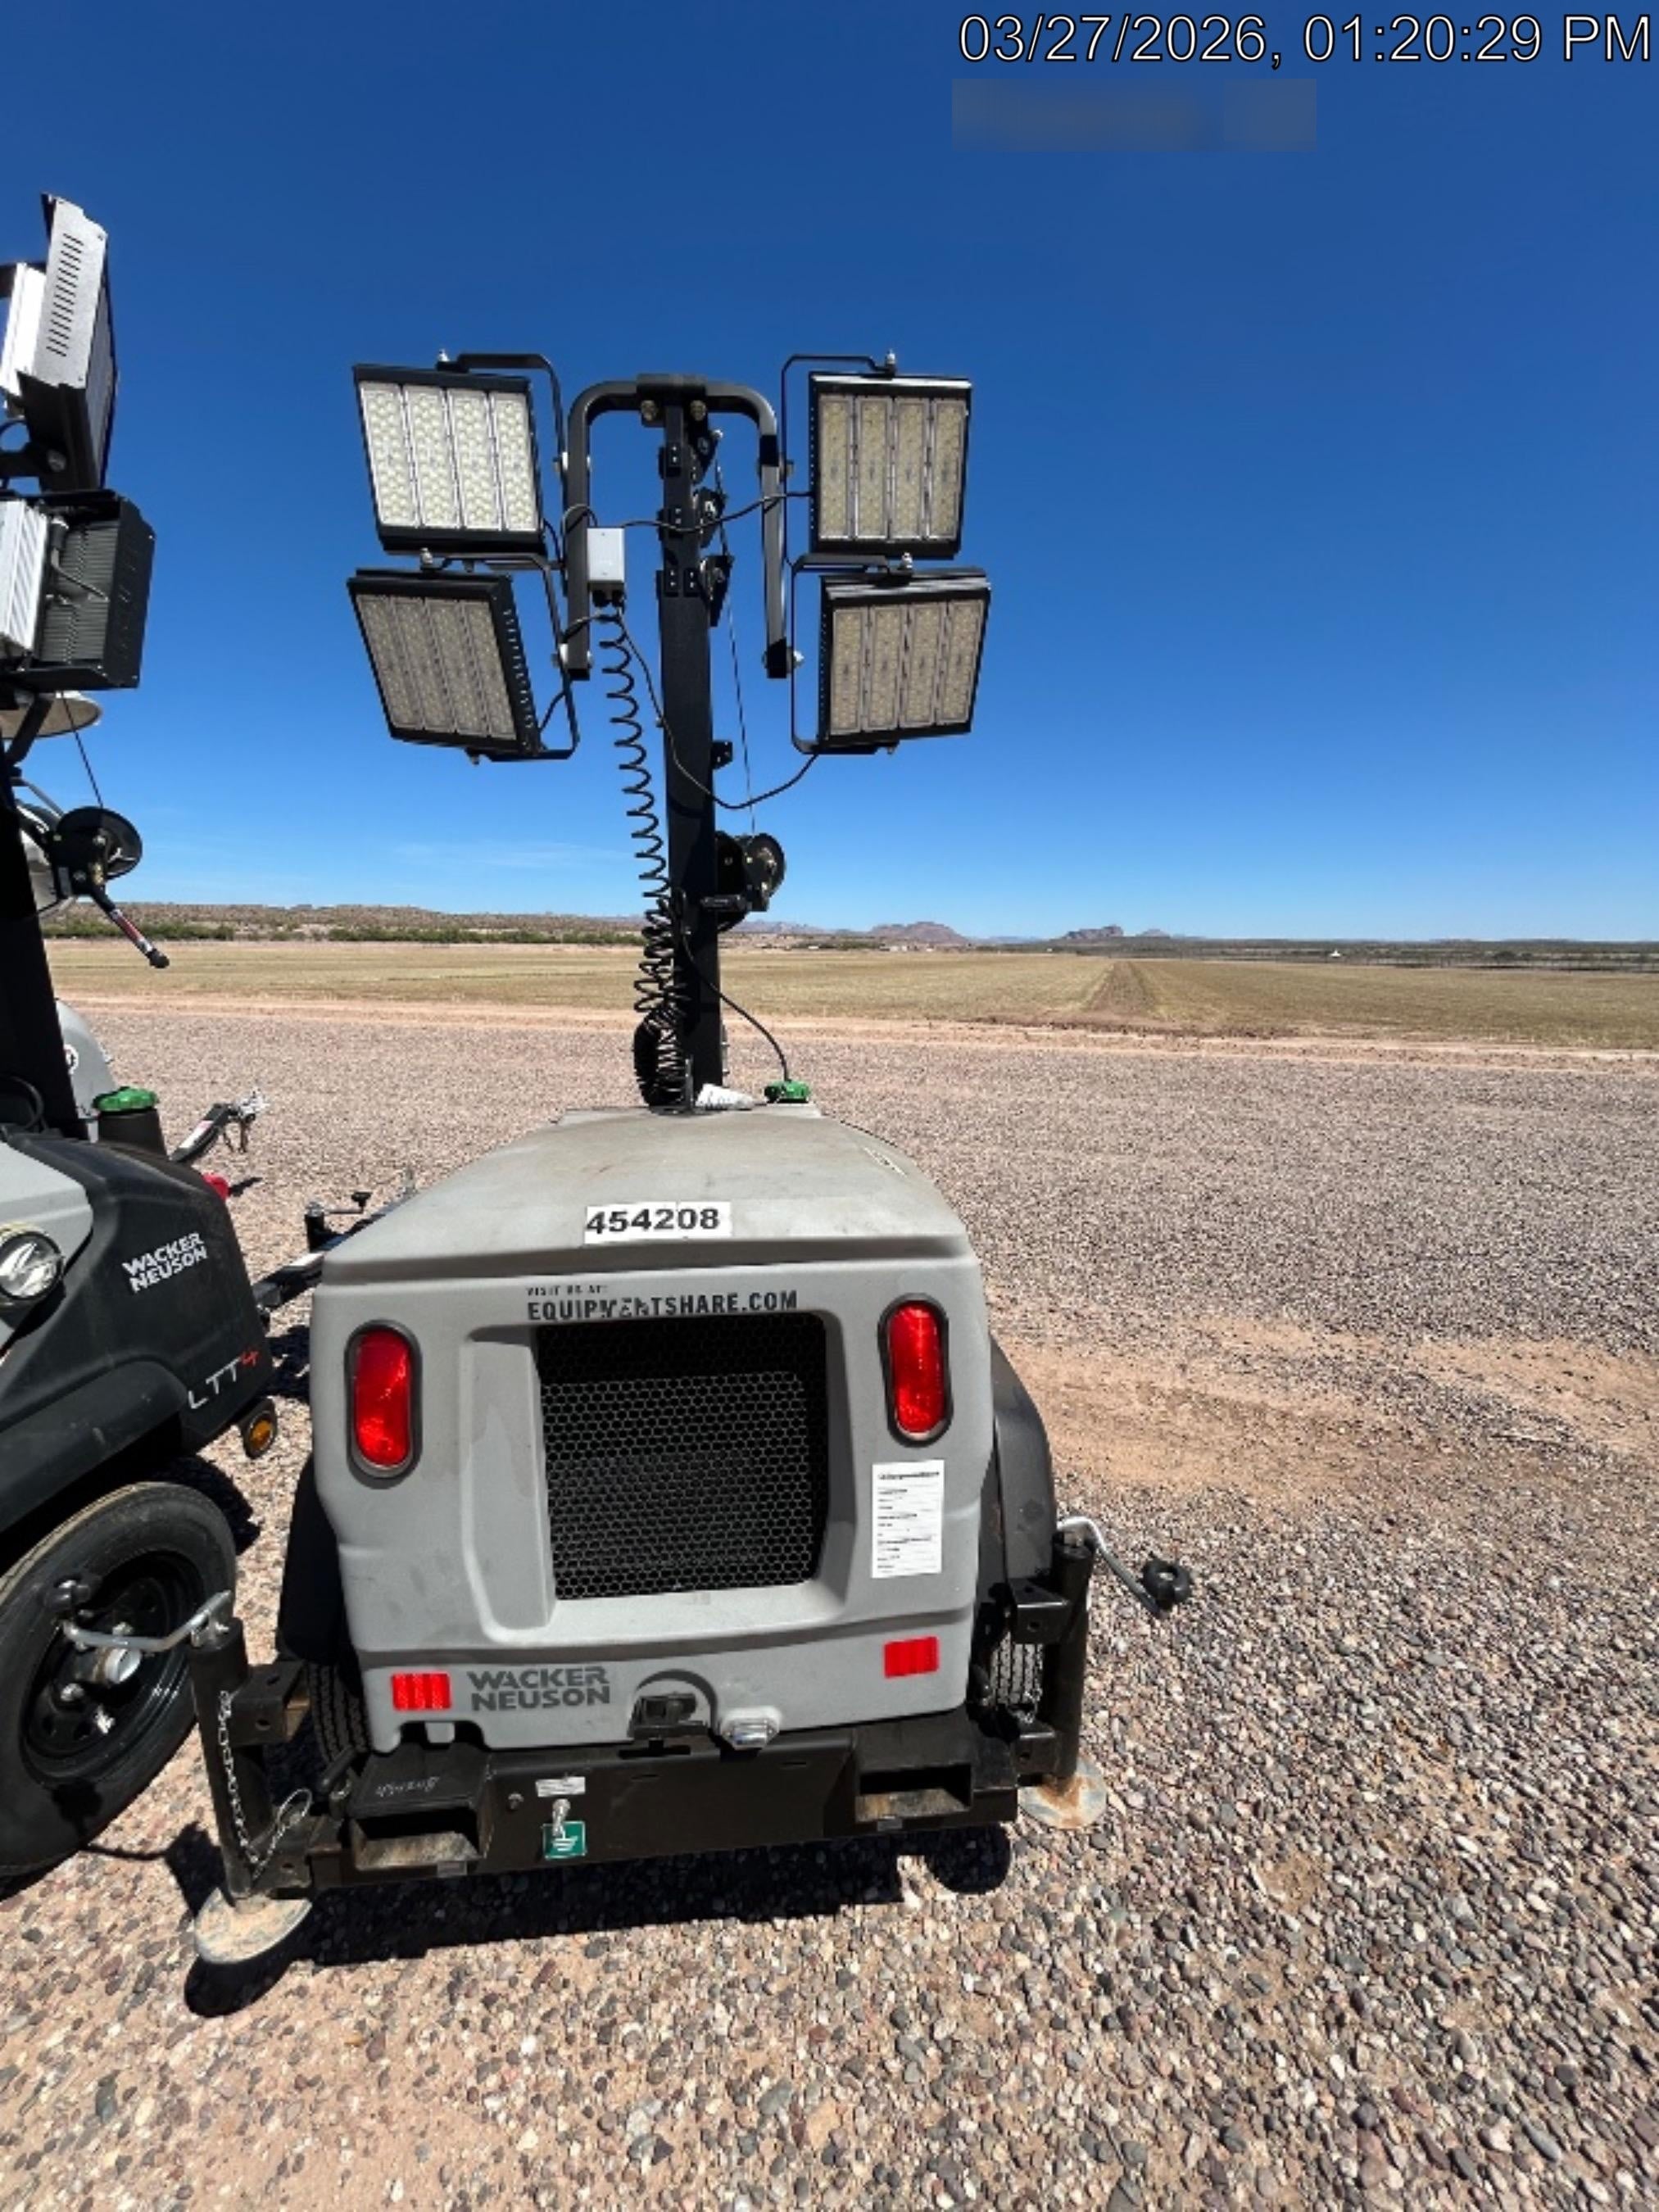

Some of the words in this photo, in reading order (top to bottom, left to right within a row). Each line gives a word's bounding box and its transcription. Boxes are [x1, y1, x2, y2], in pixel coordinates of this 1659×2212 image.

[585, 1208, 719, 1234] 454208
[122, 1233, 203, 1276] WACKER
[129, 1248, 208, 1293] NEUSON
[188, 1351, 260, 1409] LTT4
[467, 1666, 610, 1690] WACKER
[471, 1686, 611, 1711] NEUSON
